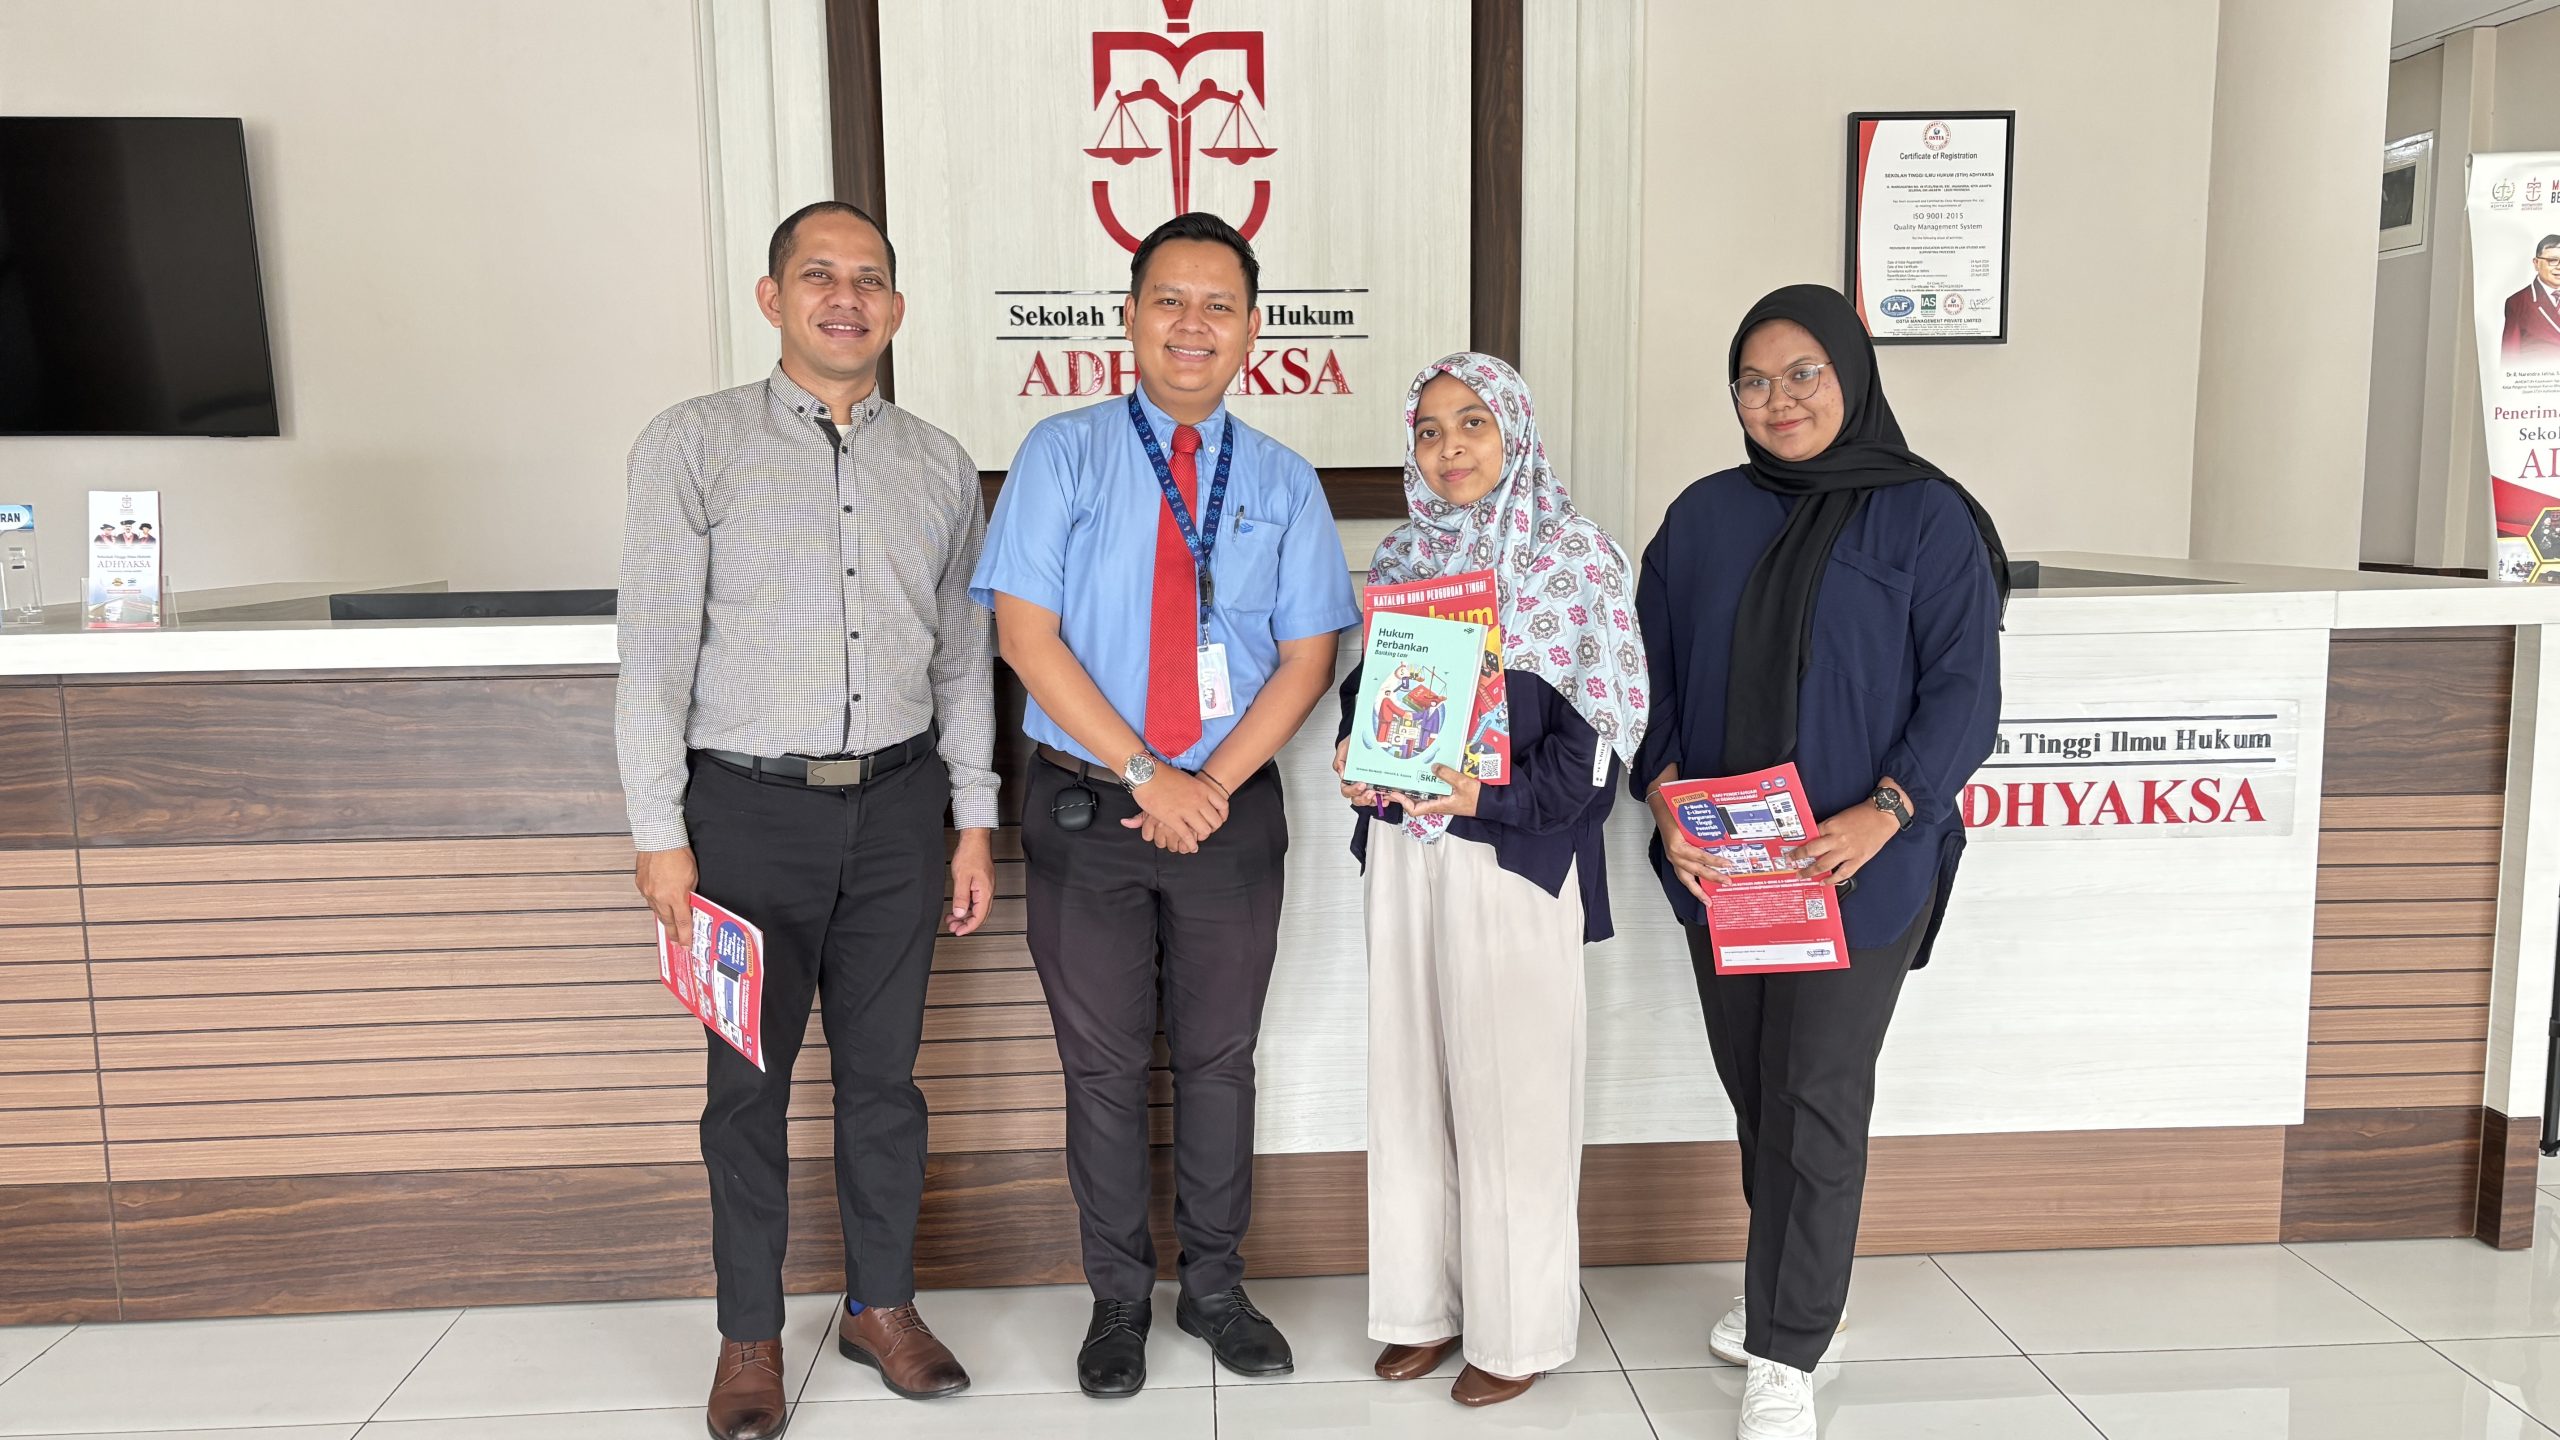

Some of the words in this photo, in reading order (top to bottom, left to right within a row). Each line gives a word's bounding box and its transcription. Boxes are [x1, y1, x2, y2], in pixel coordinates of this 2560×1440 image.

[1900, 152, 1931, 160] Certificate
[1932, 152, 1939, 160] of
[1940, 152, 1978, 161] Registration
[1913, 212, 1925, 220] ISO
[1893, 223, 1917, 231] Quality
[1917, 223, 1959, 231] Management
[1960, 223, 1983, 231] System
[1887, 302, 1909, 312] IAF
[1921, 297, 1936, 307] IAS
[1010, 305, 1105, 326] Sekolah
[1266, 304, 1354, 326] Hukum
[1017, 347, 1354, 396] ADHKSA
[2494, 405, 2560, 420] Penerim
[97, 560, 151, 569] ADHYAKSA
[1373, 593, 1406, 607] KATALOG
[1407, 591, 1425, 604] BUKU
[1426, 584, 1463, 601] PERGURUAN
[1464, 580, 1487, 595] TINGGI
[1378, 627, 1414, 640] Hukum
[1374, 649, 1397, 658] Banking
[1376, 639, 1429, 654] Perbankan
[2020, 731, 2102, 759] Tinggi
[2111, 731, 2166, 752] Ilmu
[2175, 728, 2273, 751] Hukum
[1962, 777, 2268, 828] DHYAKSA
